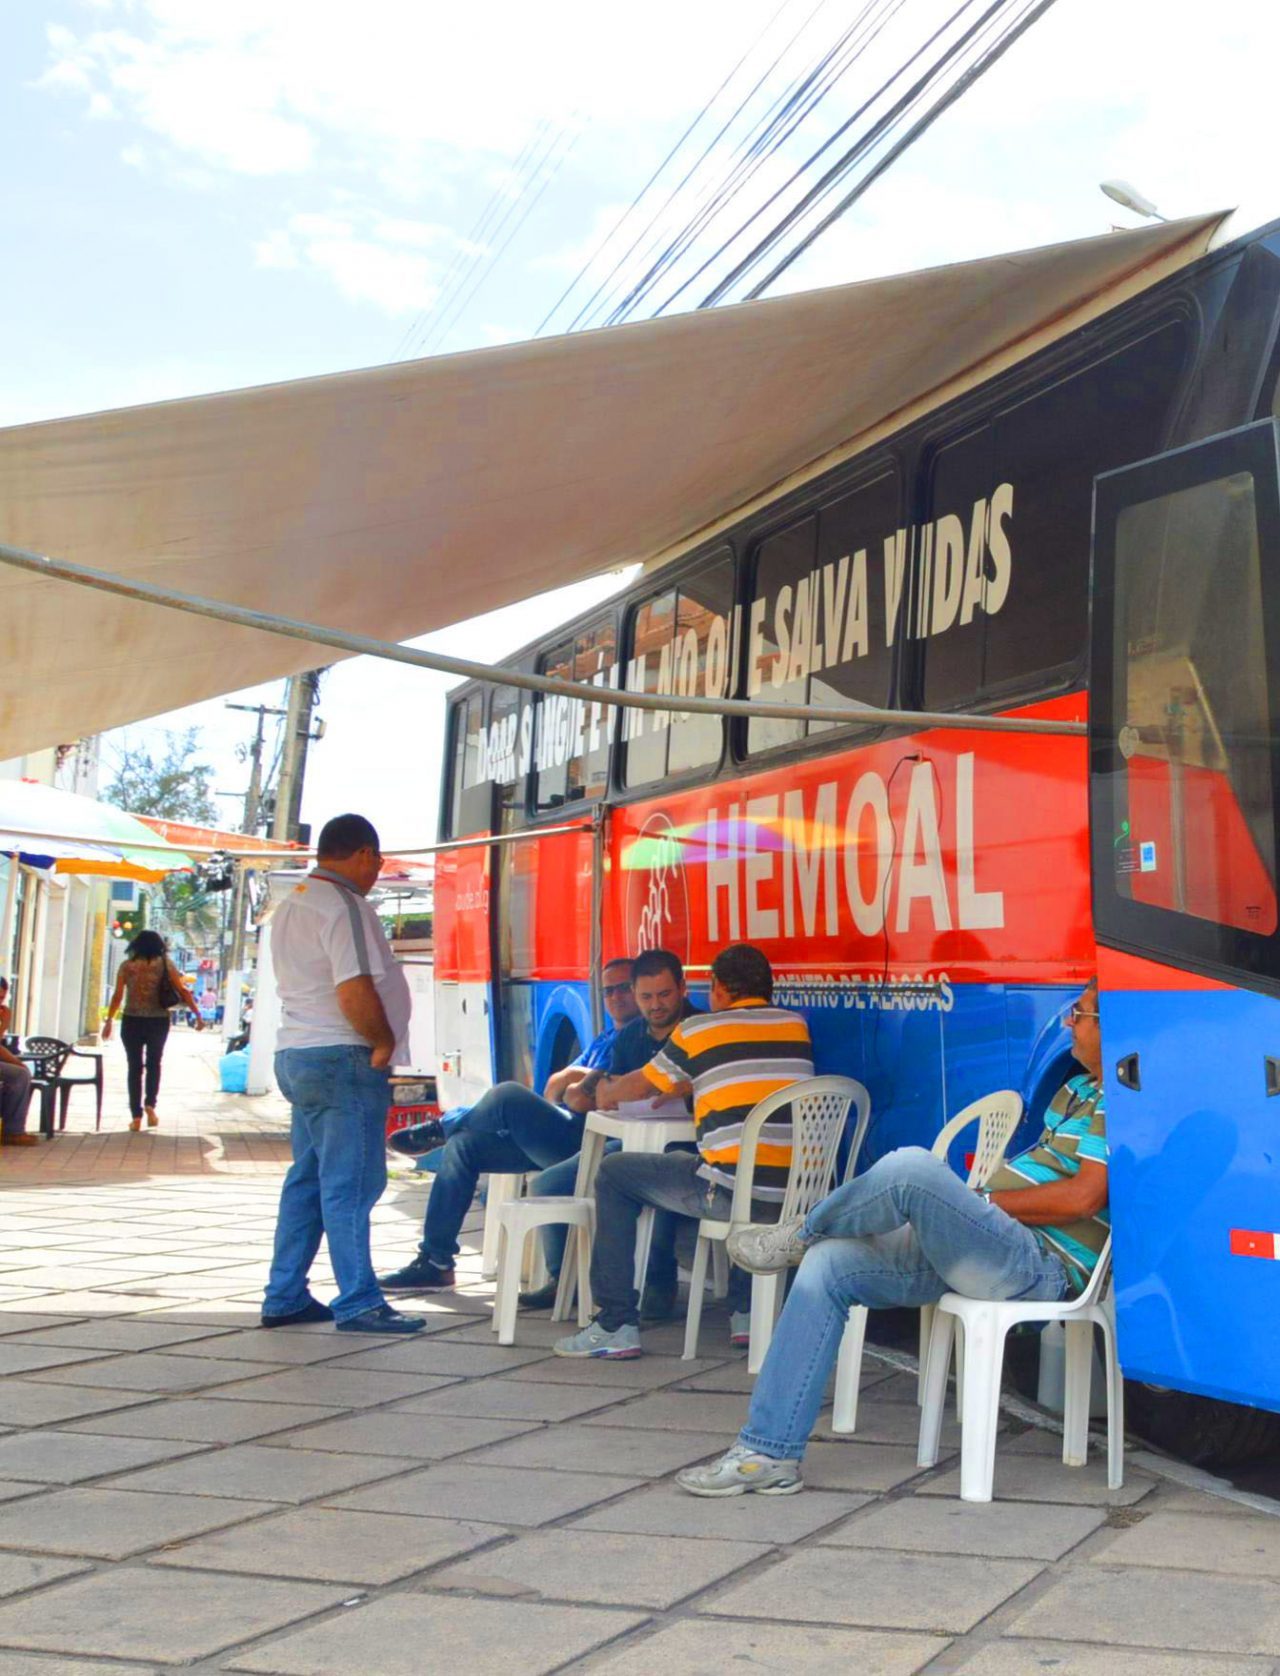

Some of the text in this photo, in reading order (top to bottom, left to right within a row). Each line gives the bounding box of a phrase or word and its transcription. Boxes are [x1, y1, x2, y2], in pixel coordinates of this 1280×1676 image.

[771, 547, 869, 690] SALVA
[884, 482, 1014, 648] VIDAS
[706, 751, 1005, 942] HEMOAL
[839, 973, 866, 1010] DE
[867, 971, 955, 1012] ALAGOAS
